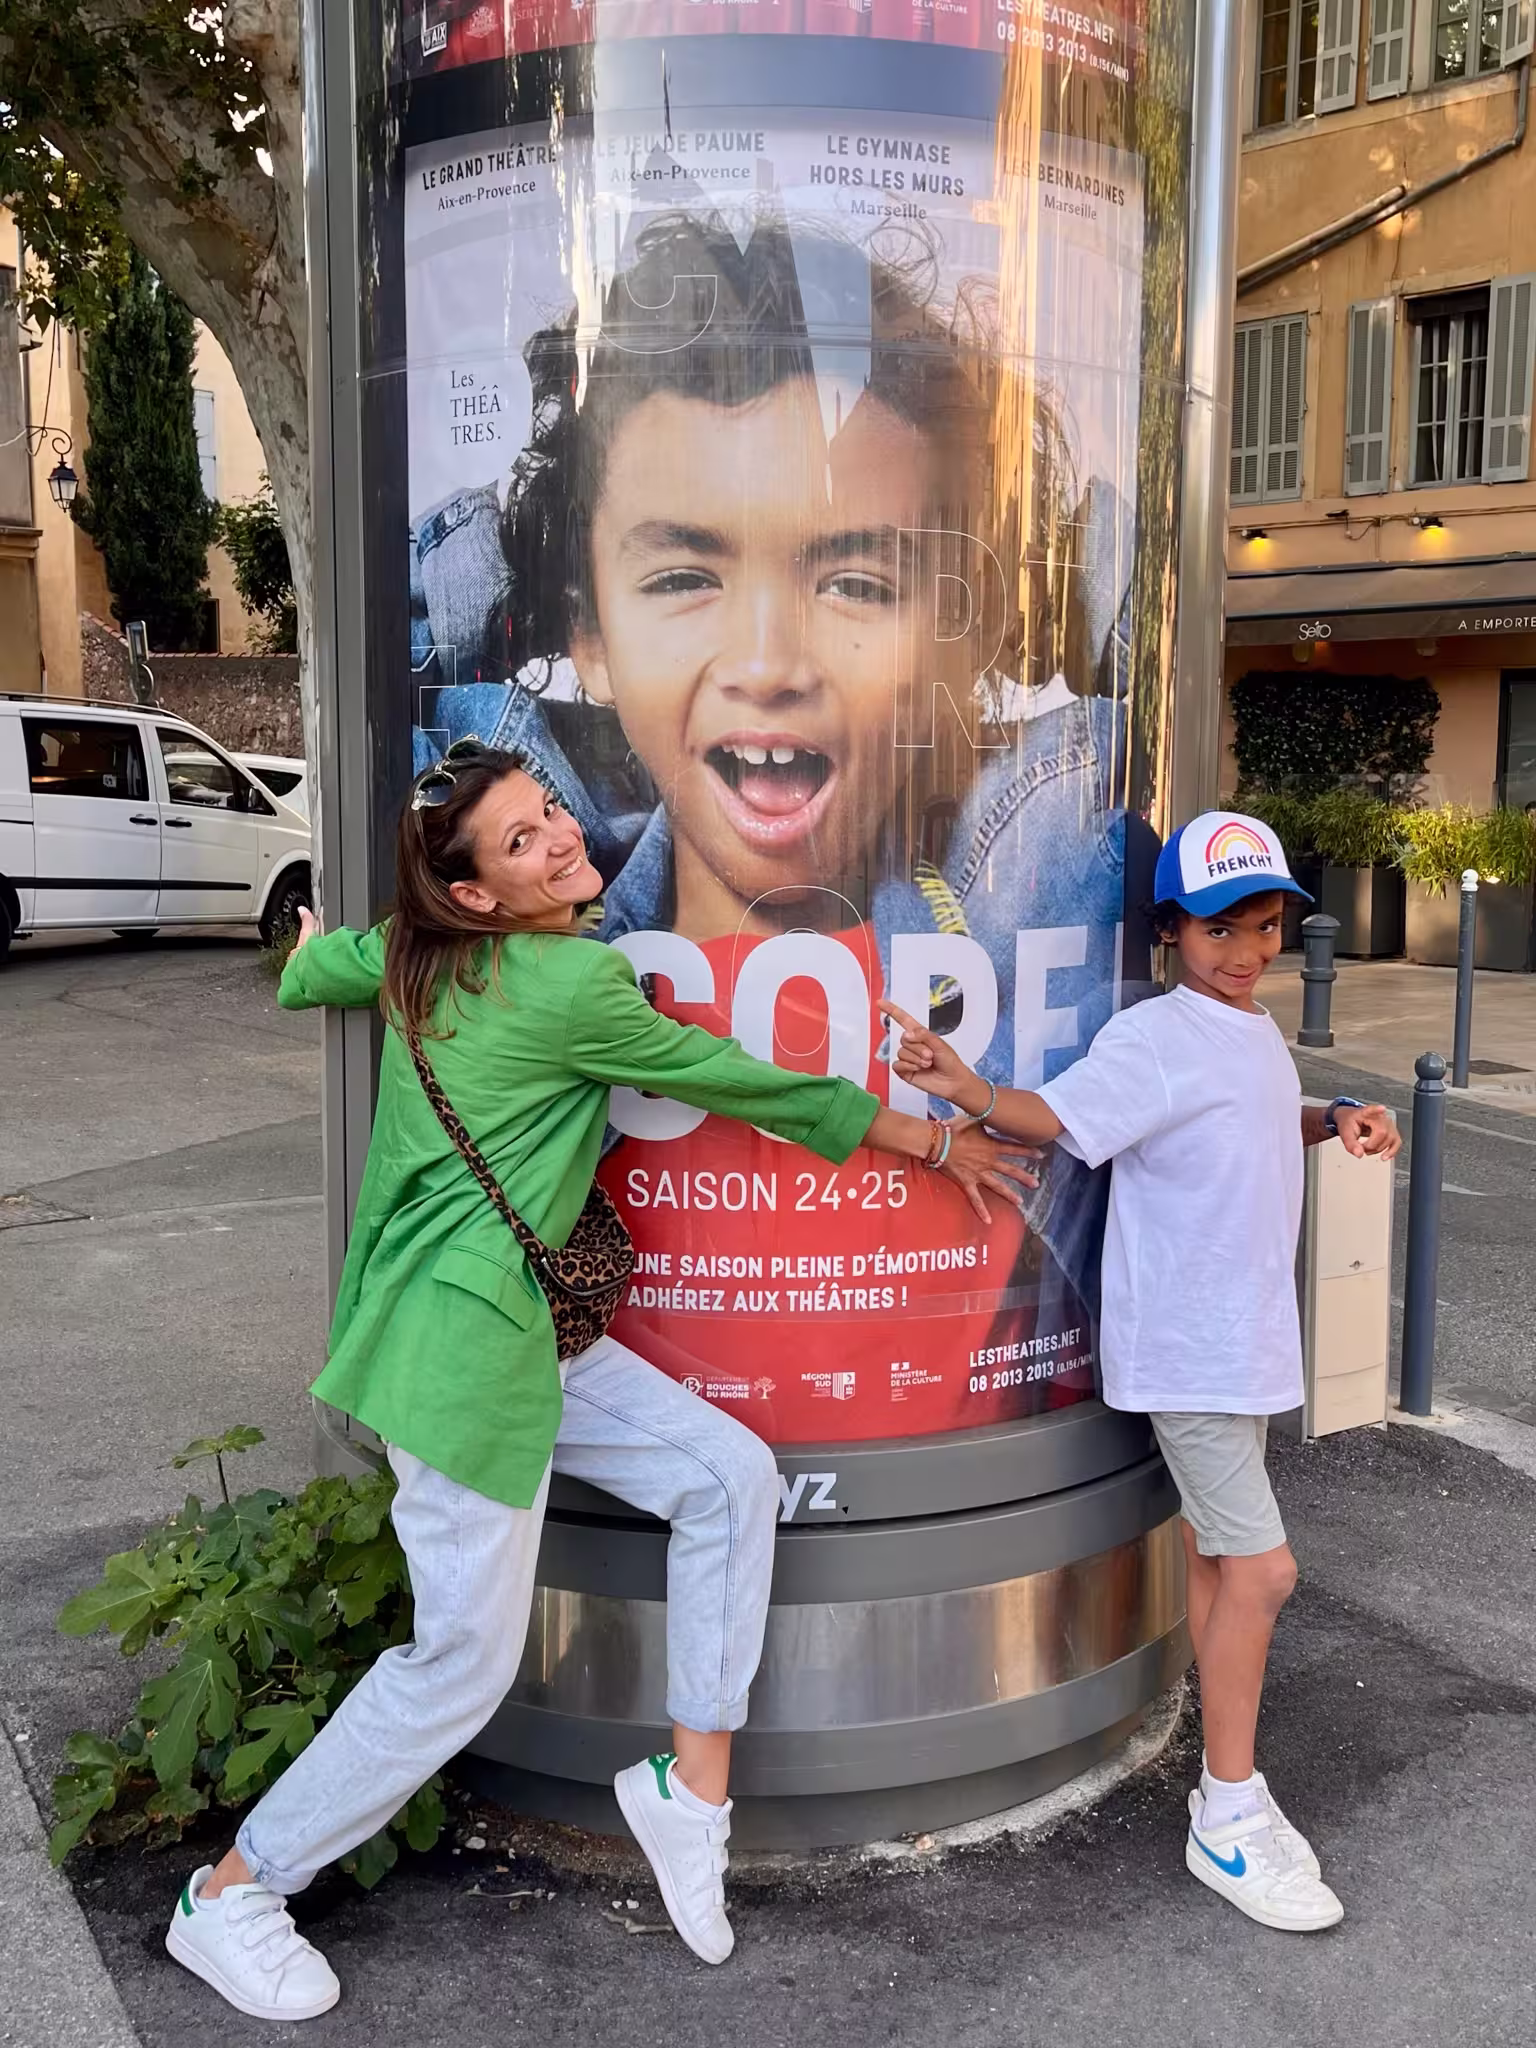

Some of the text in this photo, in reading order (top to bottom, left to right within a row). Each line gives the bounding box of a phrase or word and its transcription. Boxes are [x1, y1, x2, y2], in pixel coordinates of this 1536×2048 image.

[935, 3, 968, 14] CULTURE
[432, 24, 446, 43] AIX
[997, 22, 1016, 42] 08
[1022, 27, 1054, 51] 2013
[1058, 37, 1087, 63] 2013
[596, 132, 765, 158] LE JEU DE PAUME
[827, 135, 951, 165] LE GYMNASE
[423, 170, 436, 191] LE
[440, 157, 483, 185] GRAND
[610, 165, 750, 182] Aix-en-Provence
[810, 165, 964, 196] HORS LES MURS
[1038, 163, 1125, 207] BERNARDINES
[438, 180, 536, 211] Aix-en-Provence
[1044, 194, 1097, 220] Marseille
[851, 200, 927, 220] Marseille
[451, 370, 474, 389] Les
[450, 384, 501, 418] THÉÂ
[450, 421, 501, 446] TRES.
[1458, 620, 1467, 630] A
[1207, 853, 1273, 877] FRENCHY
[627, 1168, 777, 1211] SAISON
[680, 1255, 763, 1278] SAISON
[771, 1255, 844, 1279] PLEINE
[627, 1280, 725, 1311] ADHÉREZ
[733, 1290, 779, 1312] AUX
[786, 1282, 894, 1311] THÉÂTRES
[970, 1327, 1081, 1368] LESTHEATRES.NET
[801, 1372, 831, 1381] RÉGION
[815, 1380, 831, 1388] SUD
[890, 1369, 928, 1379] MINISTÈRE
[890, 1375, 942, 1387] DE LA CULTURE
[969, 1375, 988, 1393] 08
[992, 1368, 1023, 1389] 2013
[1026, 1360, 1054, 1382] 2013
[706, 1383, 749, 1391] BOUCHES
